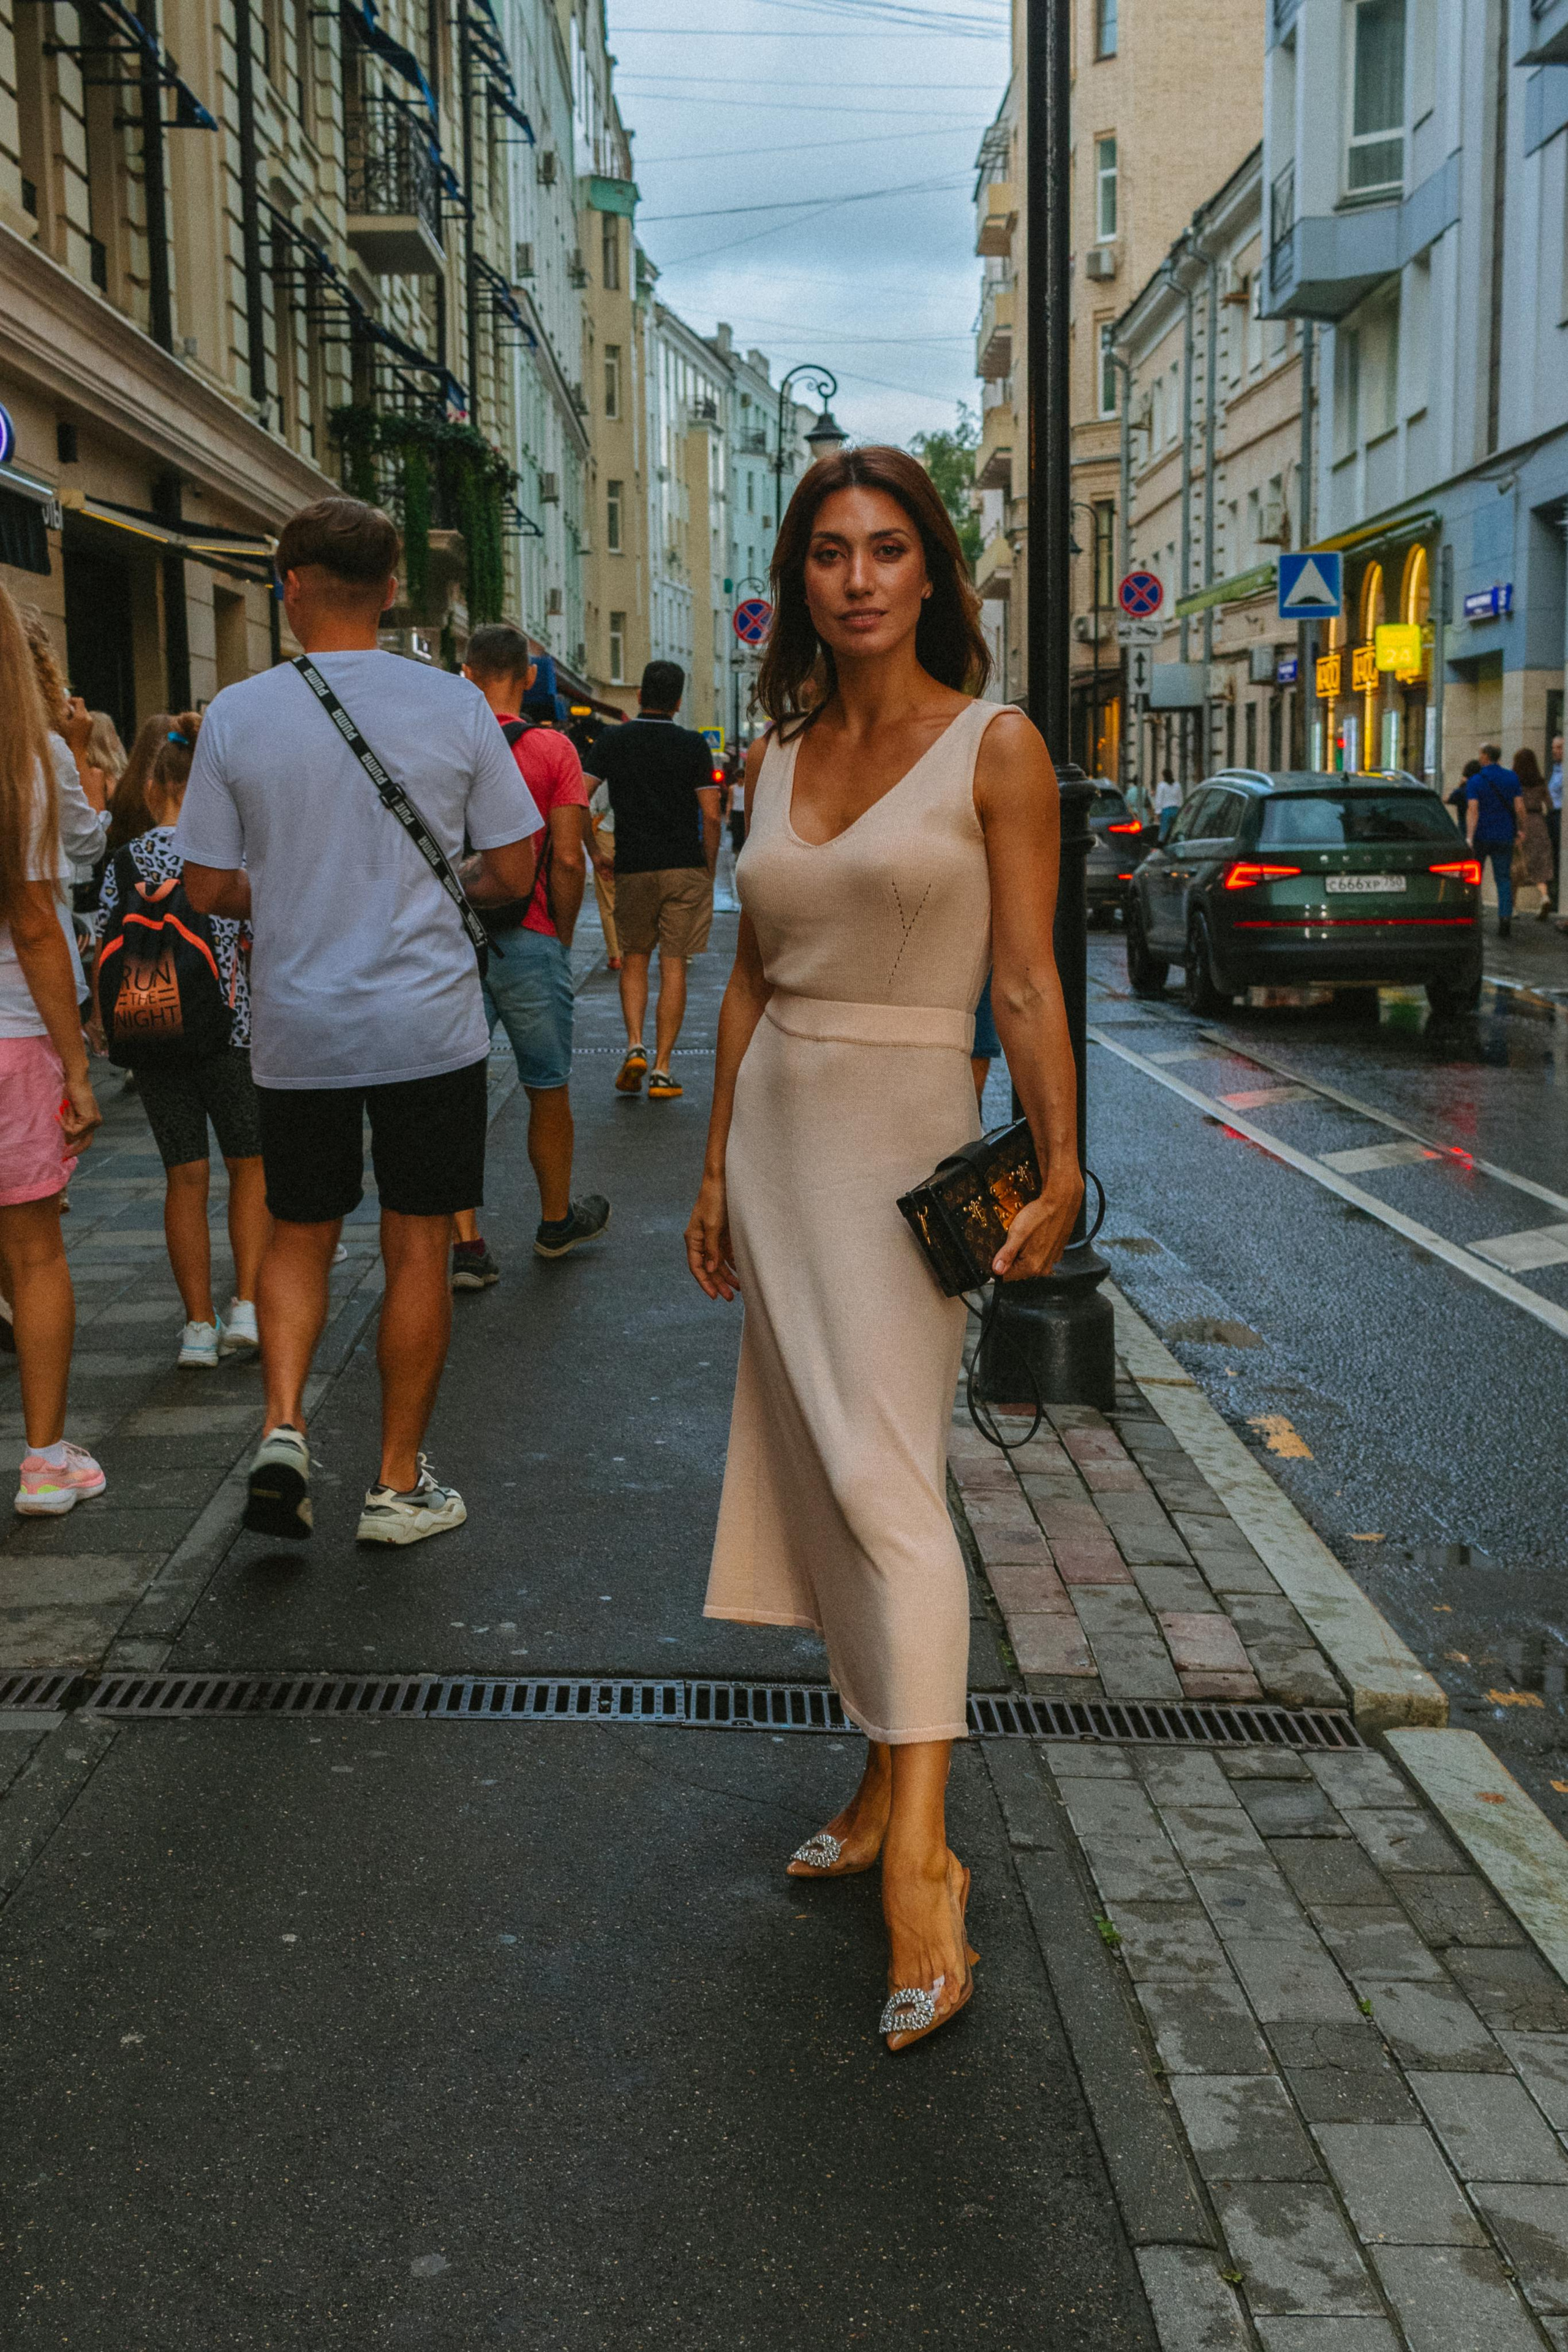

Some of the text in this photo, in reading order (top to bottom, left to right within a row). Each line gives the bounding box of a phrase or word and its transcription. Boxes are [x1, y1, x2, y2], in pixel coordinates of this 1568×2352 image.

[303, 667, 330, 697] PUMA
[331, 708, 359, 741] PUMA
[360, 752, 388, 785] PUMA
[418, 835, 441, 866] PUMA
[123, 960, 172, 992] RUN
[129, 990, 157, 1006] THE
[115, 1004, 179, 1028] NIGHT
